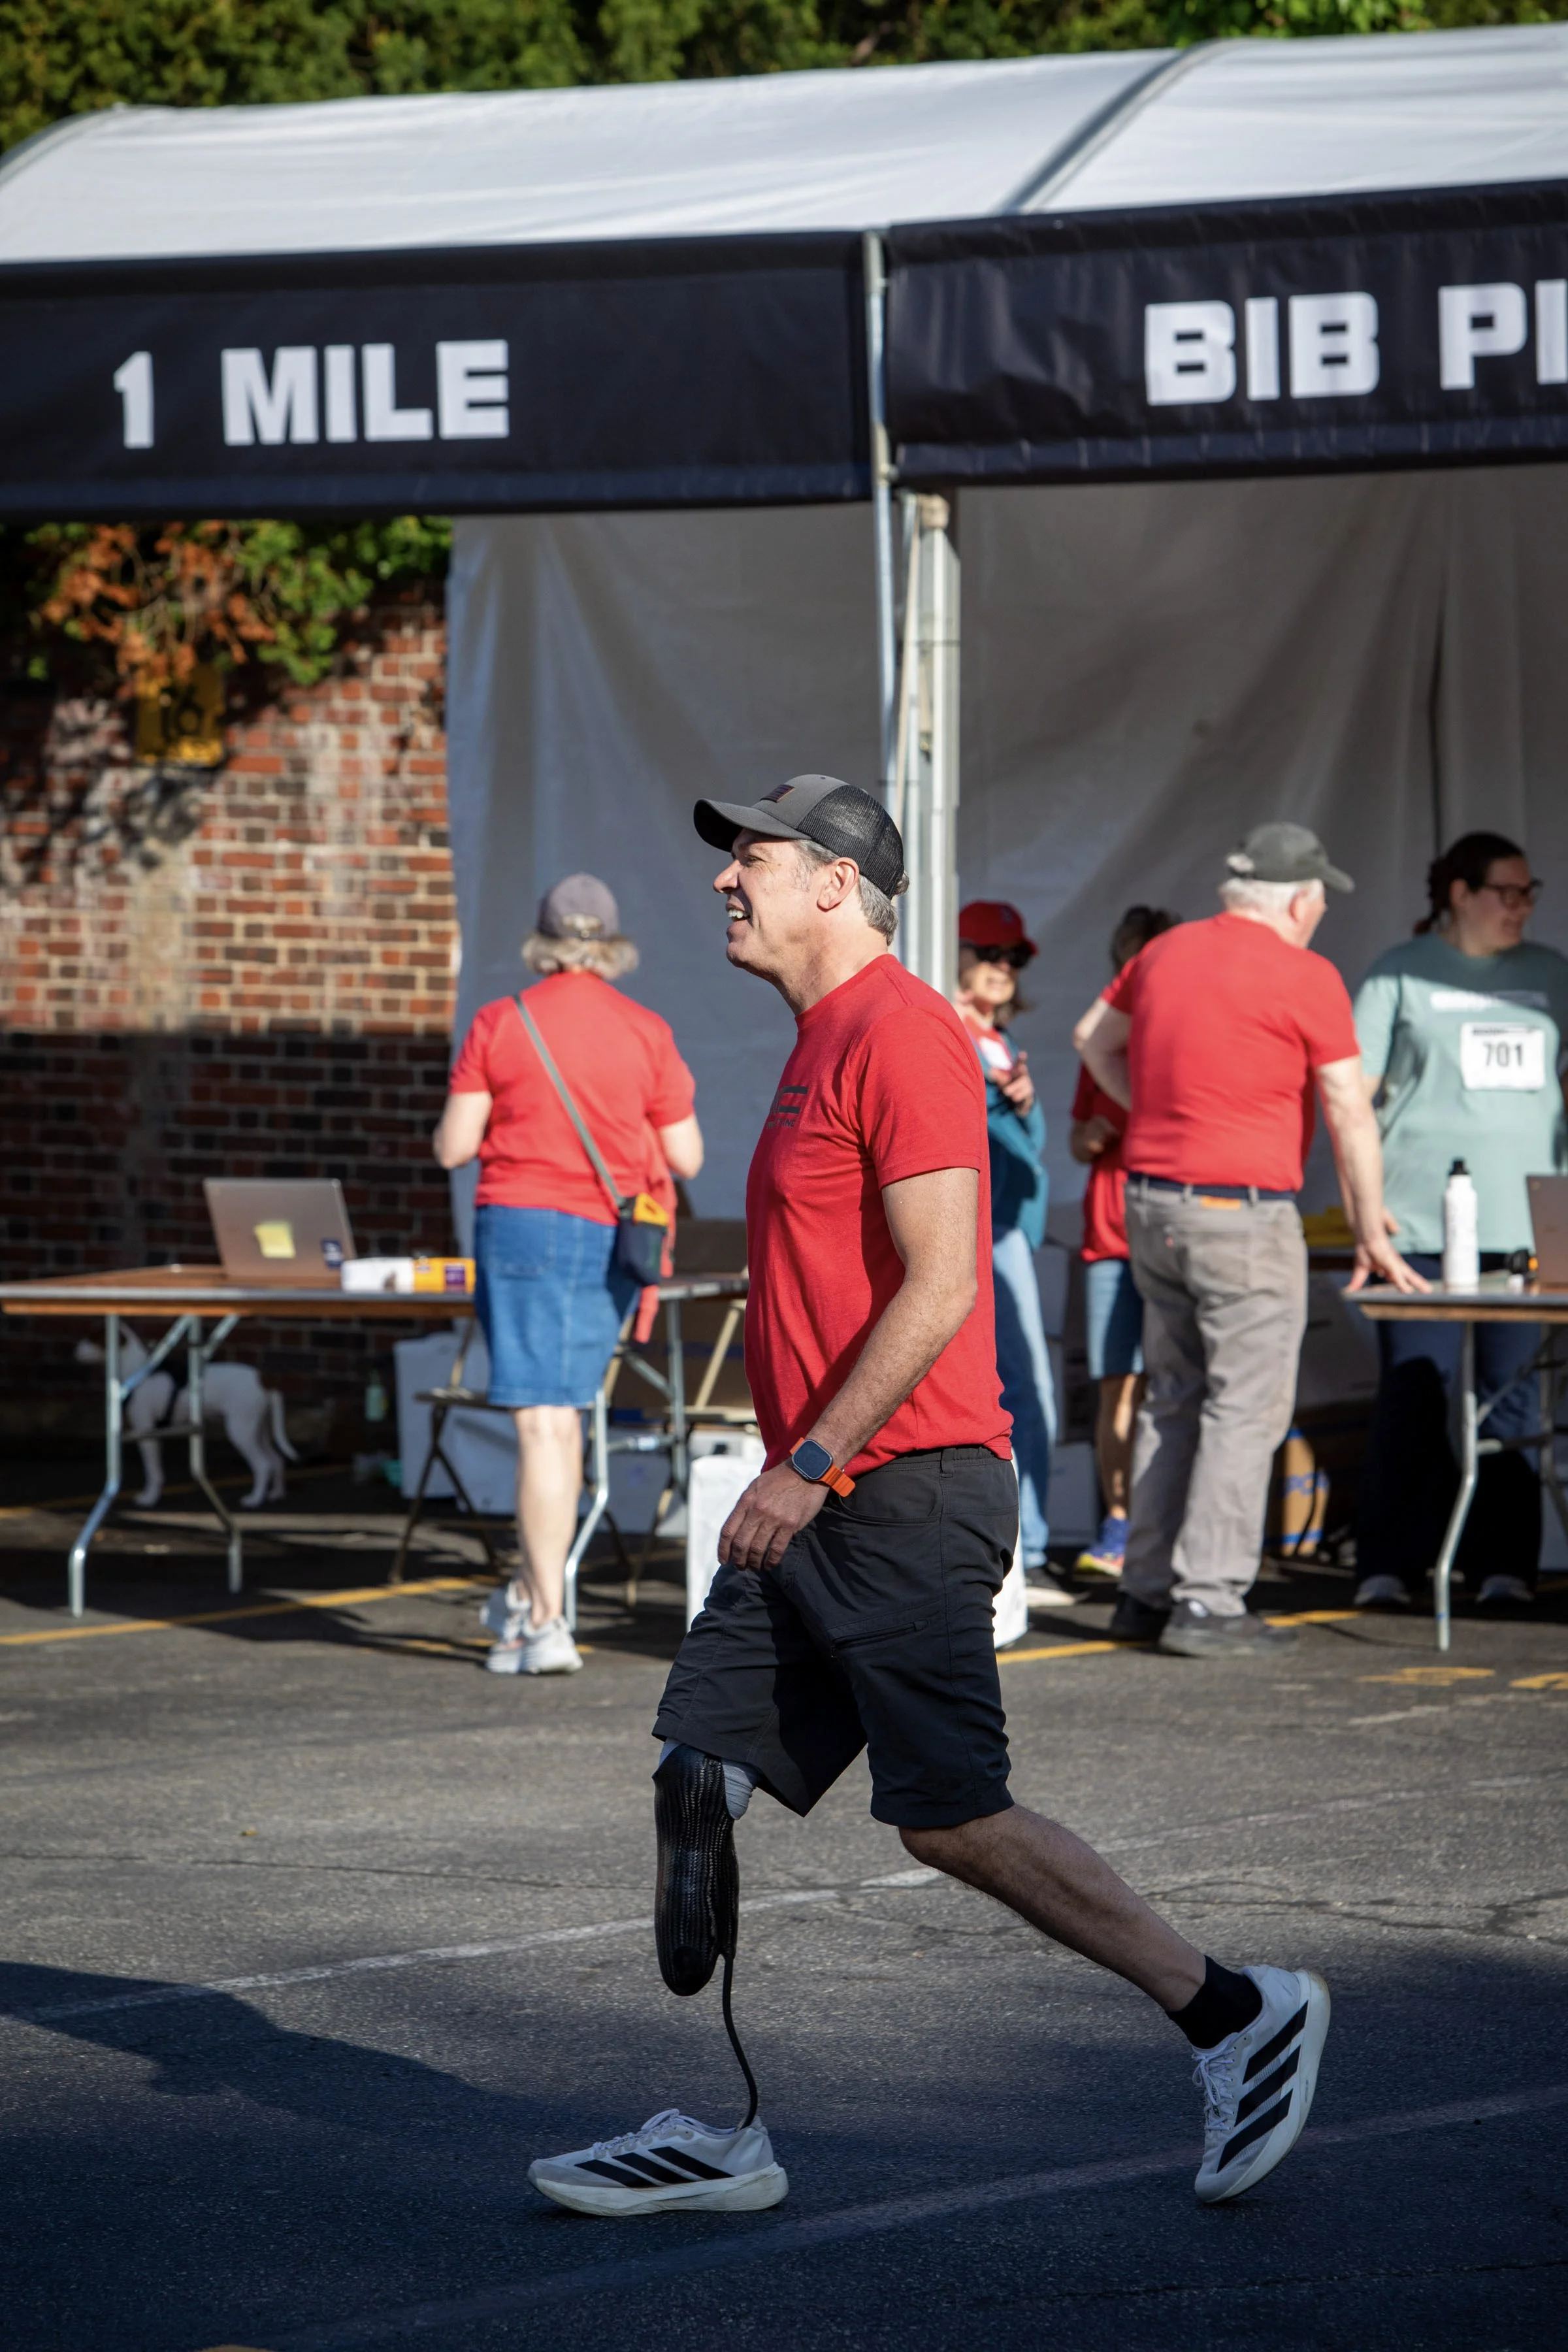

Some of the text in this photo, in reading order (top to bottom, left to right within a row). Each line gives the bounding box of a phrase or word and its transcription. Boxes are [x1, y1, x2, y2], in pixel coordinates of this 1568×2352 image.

[114, 339, 510, 448] 1 MILE
[1145, 278, 1568, 405] BIB PI
[1483, 1041, 1524, 1067] 701
